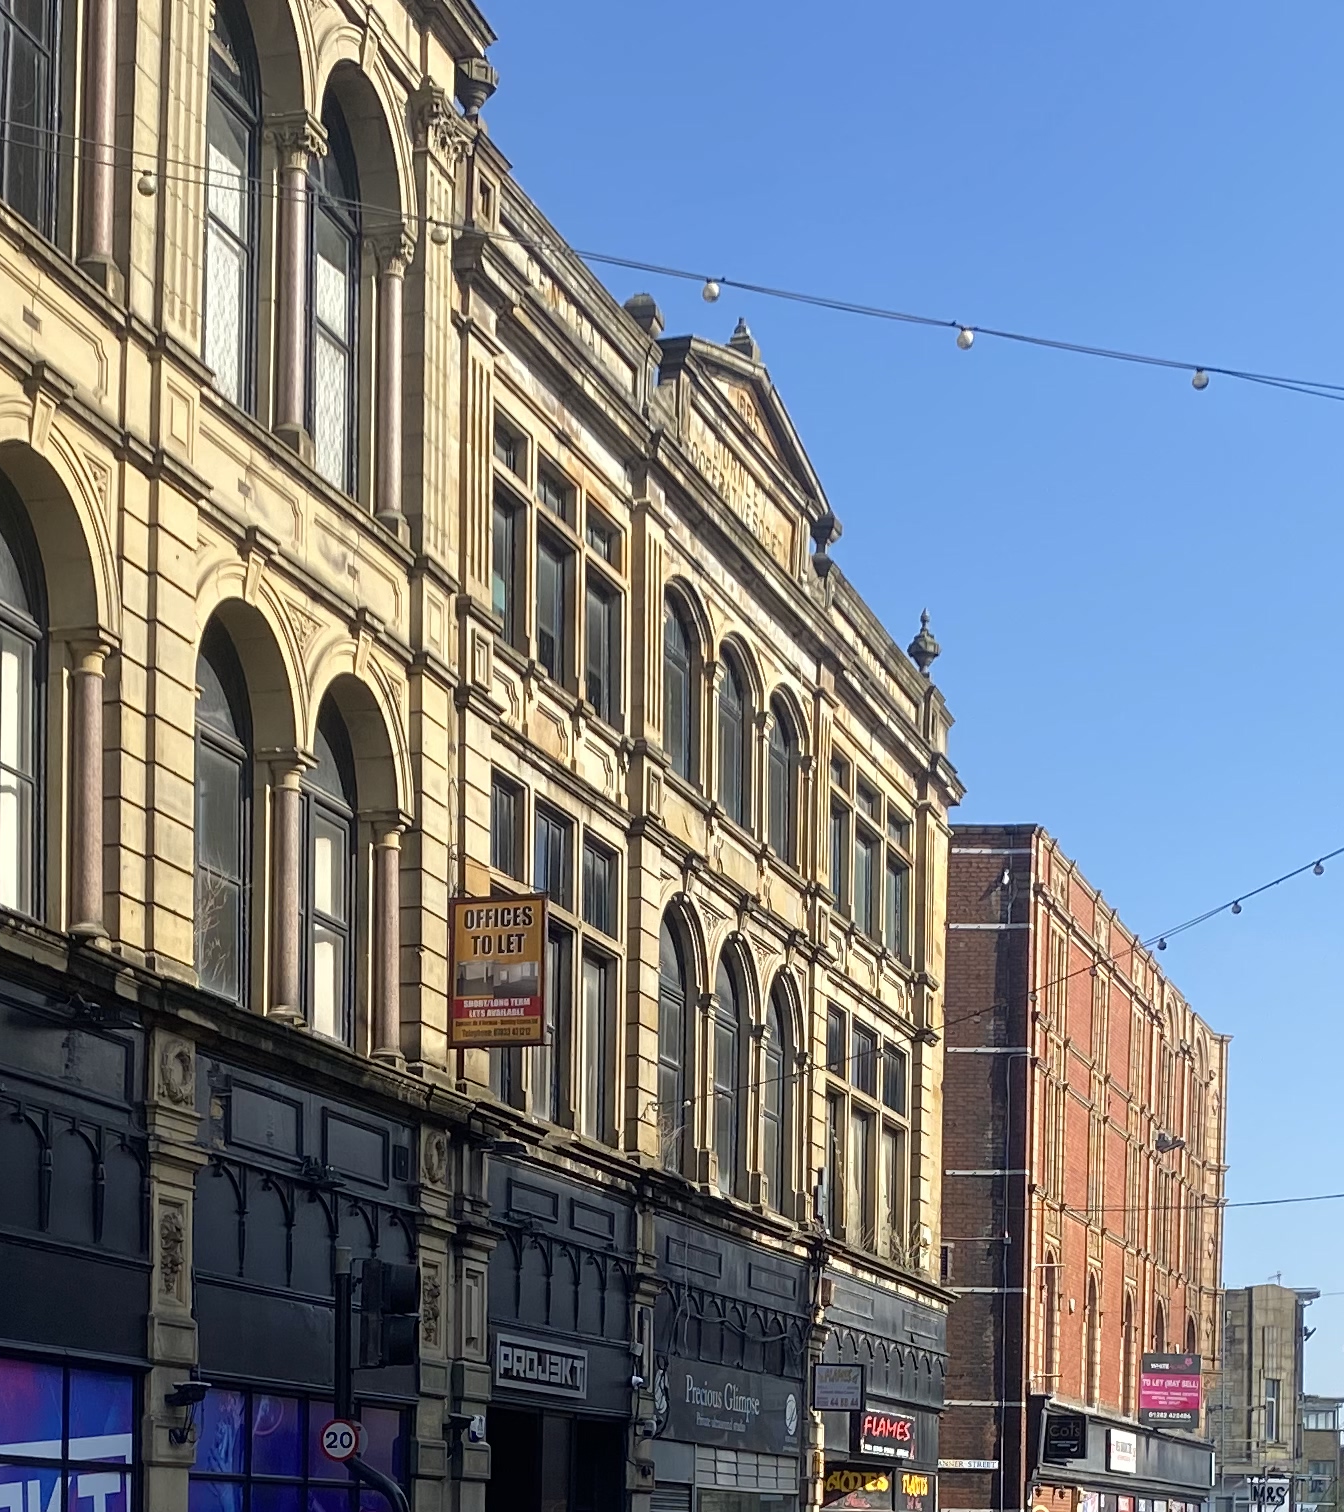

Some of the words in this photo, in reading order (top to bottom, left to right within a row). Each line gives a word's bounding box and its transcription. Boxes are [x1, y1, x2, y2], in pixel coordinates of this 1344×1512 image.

[464, 906, 534, 930] OFFICES
[471, 935, 493, 956] TO
[497, 933, 526, 955] LET
[685, 1374, 723, 1409] Precious
[724, 1382, 760, 1423] Glimpse
[864, 1415, 911, 1441] FLAMES
[325, 1431, 353, 1450] 20
[1253, 1486, 1285, 1506] M&S
